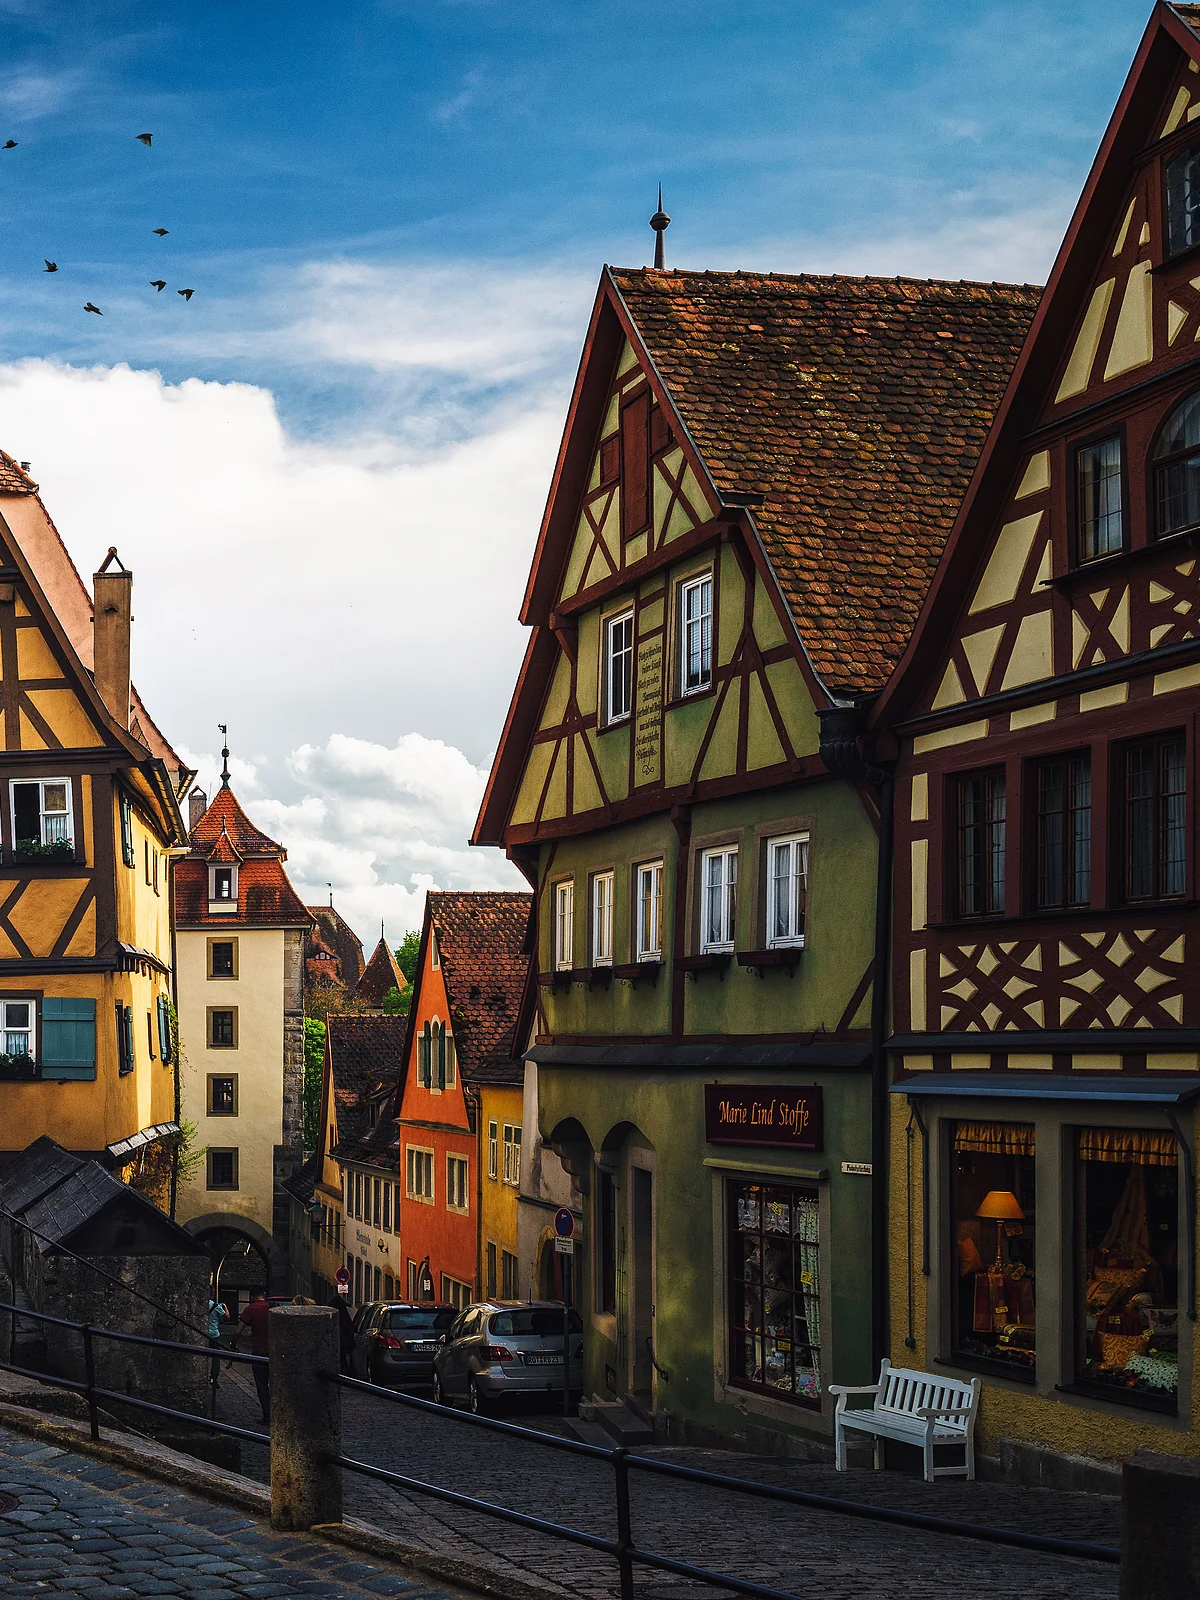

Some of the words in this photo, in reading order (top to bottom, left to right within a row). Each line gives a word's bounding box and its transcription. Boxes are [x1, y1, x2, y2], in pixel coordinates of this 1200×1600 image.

[719, 1100, 747, 1124] Marie
[750, 1099, 776, 1125] Lind
[778, 1099, 809, 1135] Stoffe
